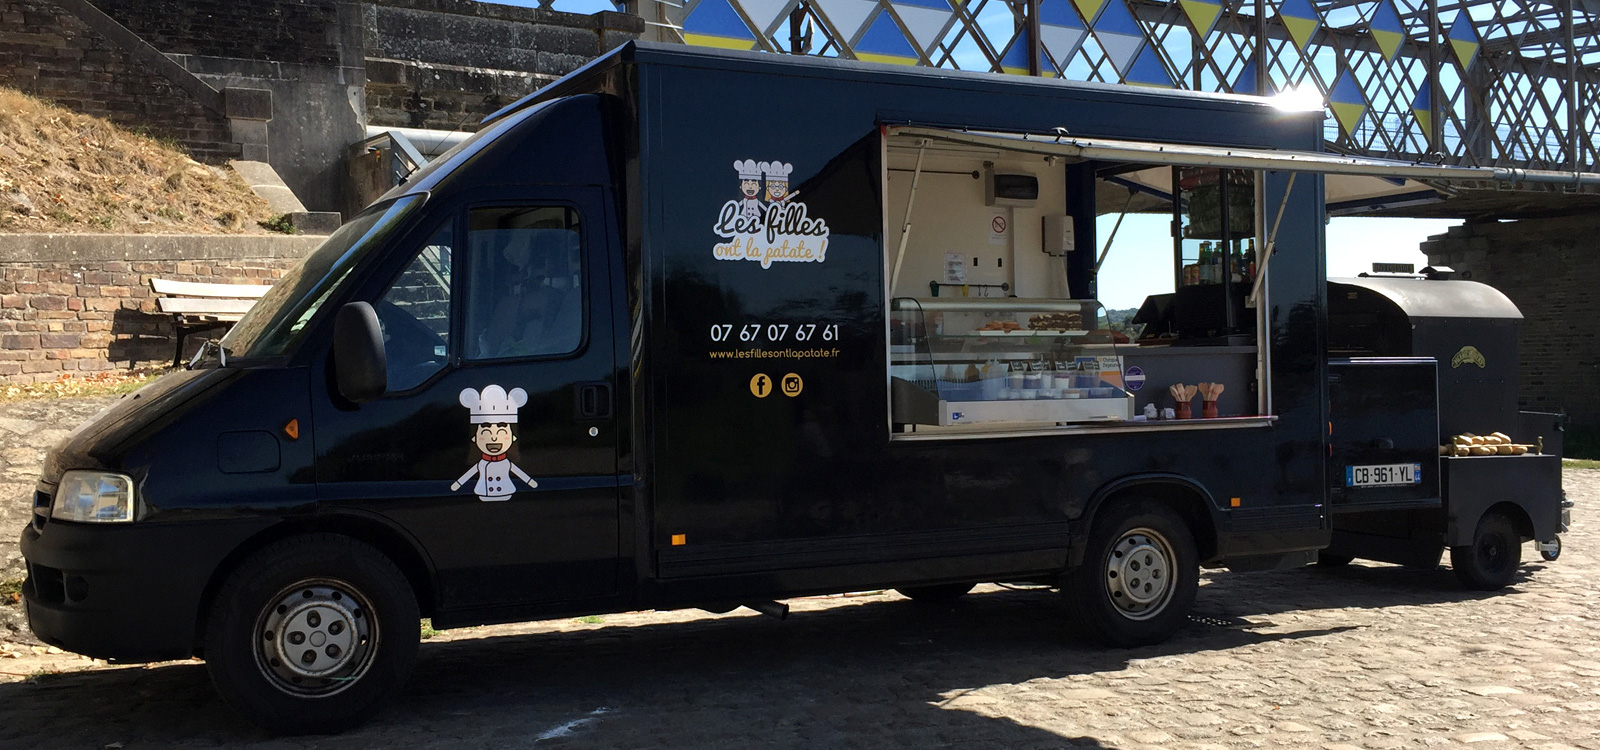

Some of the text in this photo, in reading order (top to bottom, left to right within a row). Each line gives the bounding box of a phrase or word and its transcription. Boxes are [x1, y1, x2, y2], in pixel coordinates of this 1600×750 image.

[766, 205, 826, 244] filles
[715, 237, 825, 265] ont la patate !
[710, 324, 839, 341] 07 67 07 67 61
[709, 348, 840, 360] www.lesfillesontlapatate.fr
